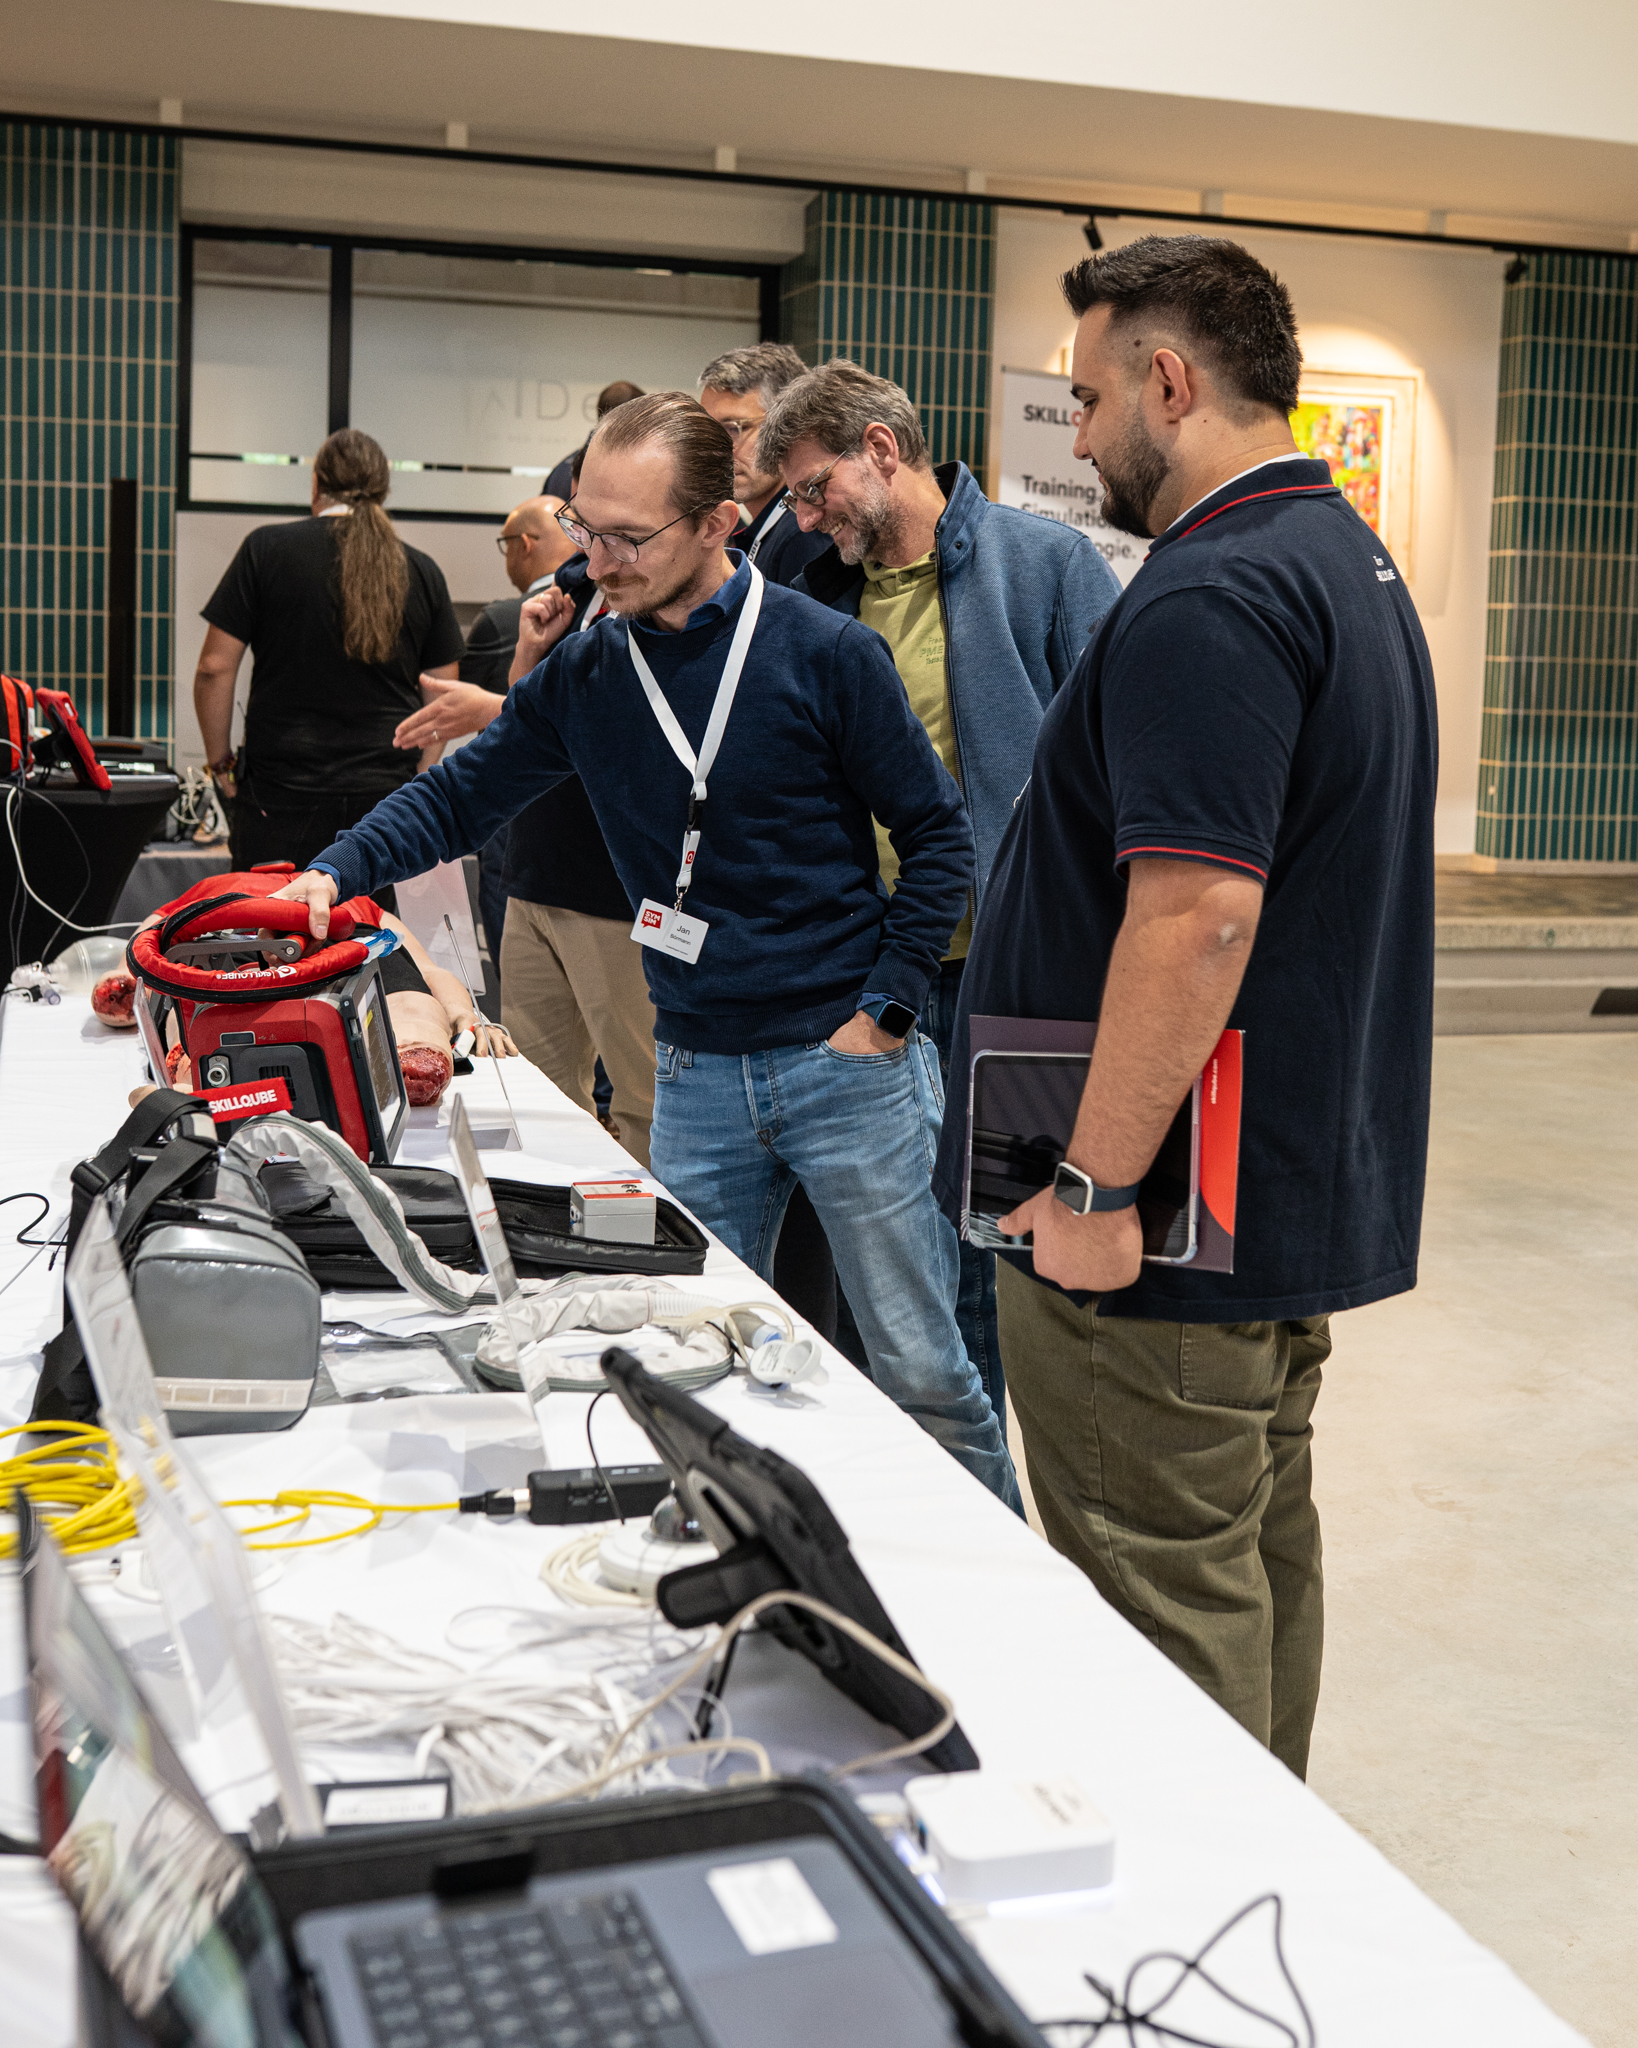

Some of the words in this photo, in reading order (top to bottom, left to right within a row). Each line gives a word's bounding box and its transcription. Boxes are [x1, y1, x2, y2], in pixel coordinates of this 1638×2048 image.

[643, 916, 656, 926] SIM
[645, 911, 661, 921] SYM
[676, 925, 691, 935] Jan
[208, 1089, 278, 1114] SKILLQUBE
